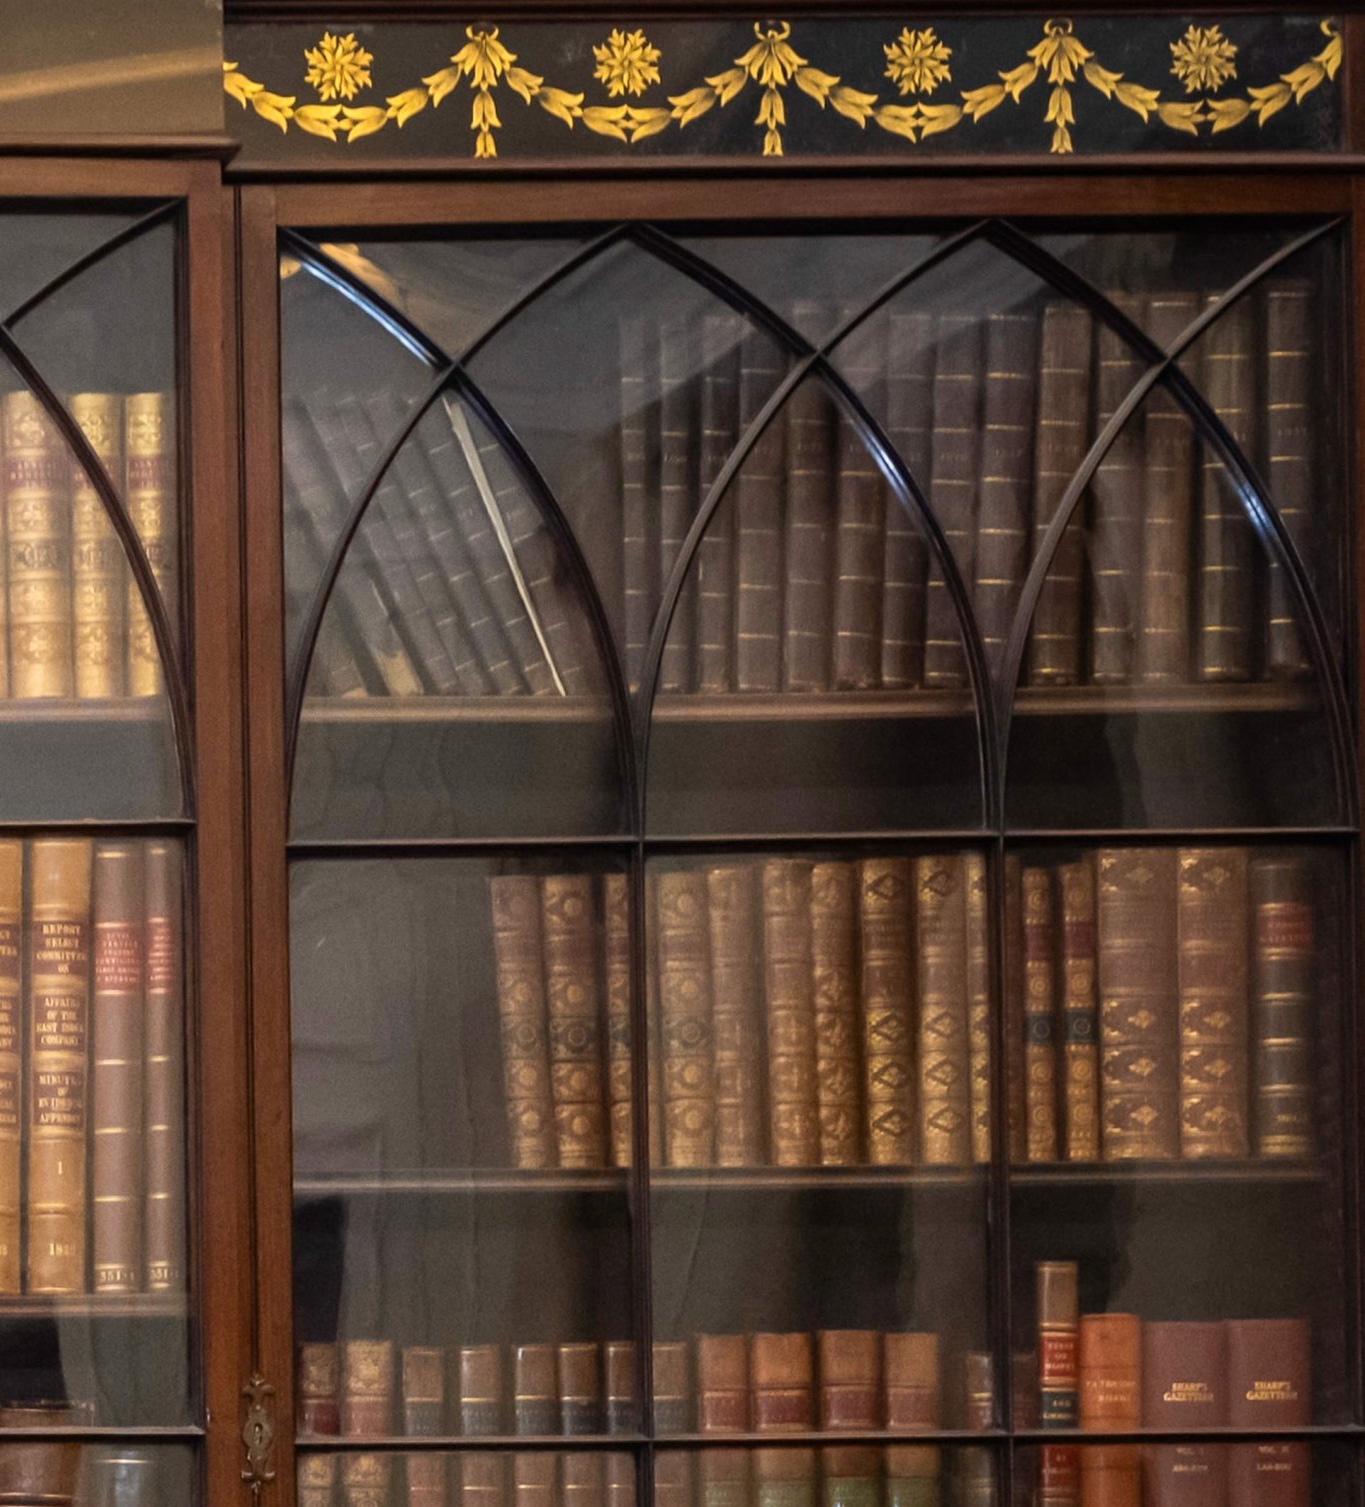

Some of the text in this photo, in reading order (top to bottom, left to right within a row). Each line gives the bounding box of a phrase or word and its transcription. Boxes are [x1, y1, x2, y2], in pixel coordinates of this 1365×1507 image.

[42, 924, 81, 935] REPORT
[44, 937, 80, 948] SELECT
[57, 962, 69, 973] ON
[46, 1010, 58, 1021] OF
[36, 1022, 58, 1033] EAST
[40, 1035, 79, 1046] COMPANY
[1171, 1381, 1209, 1392] SHARP'S
[1253, 1380, 1291, 1391] SHARP'S
[1162, 1391, 1214, 1402] GAZETTEER
[1245, 1390, 1298, 1401] GAZETTEER
